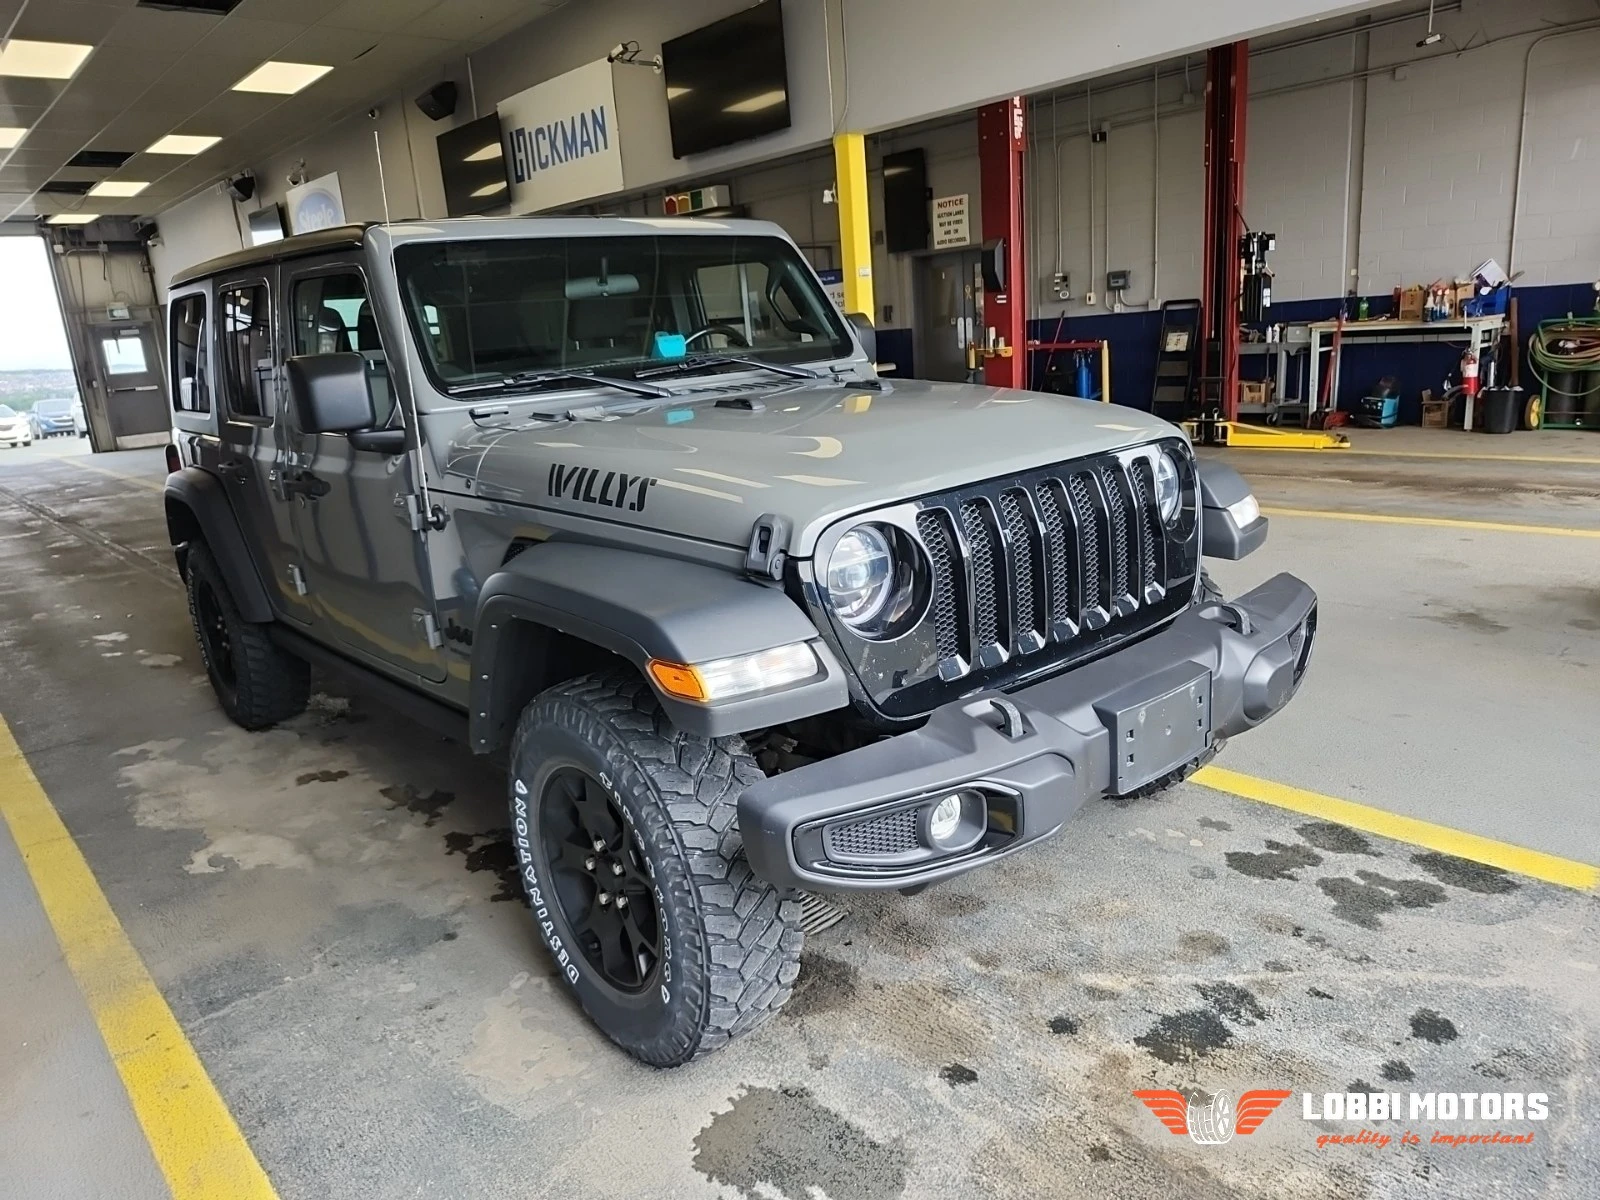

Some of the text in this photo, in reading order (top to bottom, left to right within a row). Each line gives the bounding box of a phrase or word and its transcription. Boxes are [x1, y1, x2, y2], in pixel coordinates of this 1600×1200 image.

[509, 105, 608, 184] HICKMAN
[937, 198, 964, 209] NOTICE
[548, 463, 657, 512] WILLYS
[515, 797, 580, 985] DESTINATION
